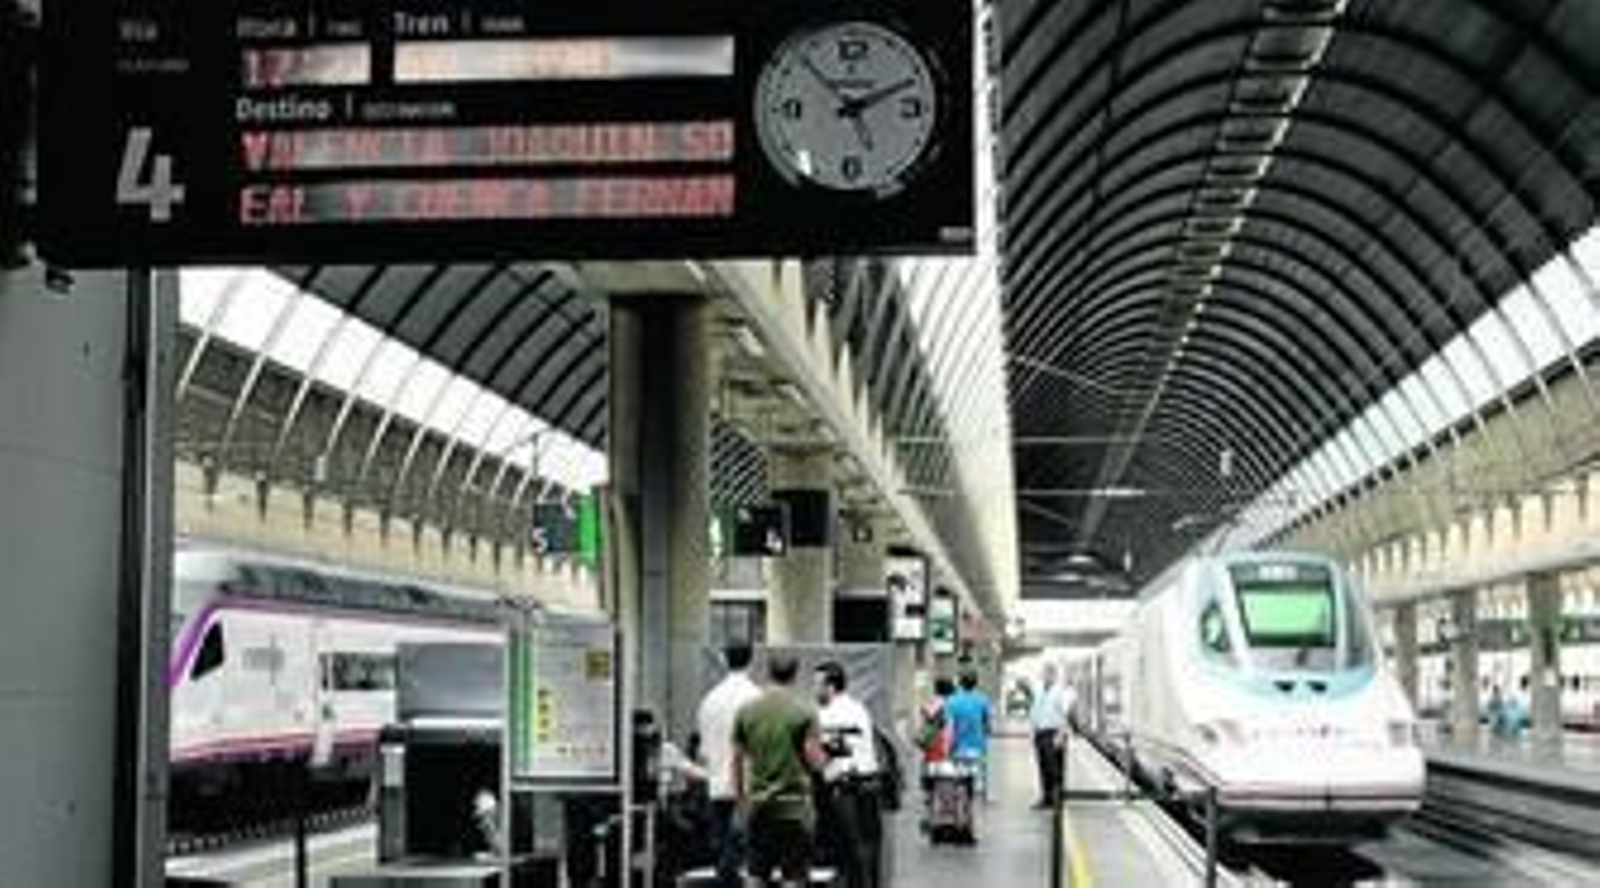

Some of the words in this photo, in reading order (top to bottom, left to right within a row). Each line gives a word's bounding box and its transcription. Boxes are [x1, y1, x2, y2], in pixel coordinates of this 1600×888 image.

[395, 11, 449, 33] Tren
[236, 97, 331, 120] Destino
[116, 126, 185, 222] 4
